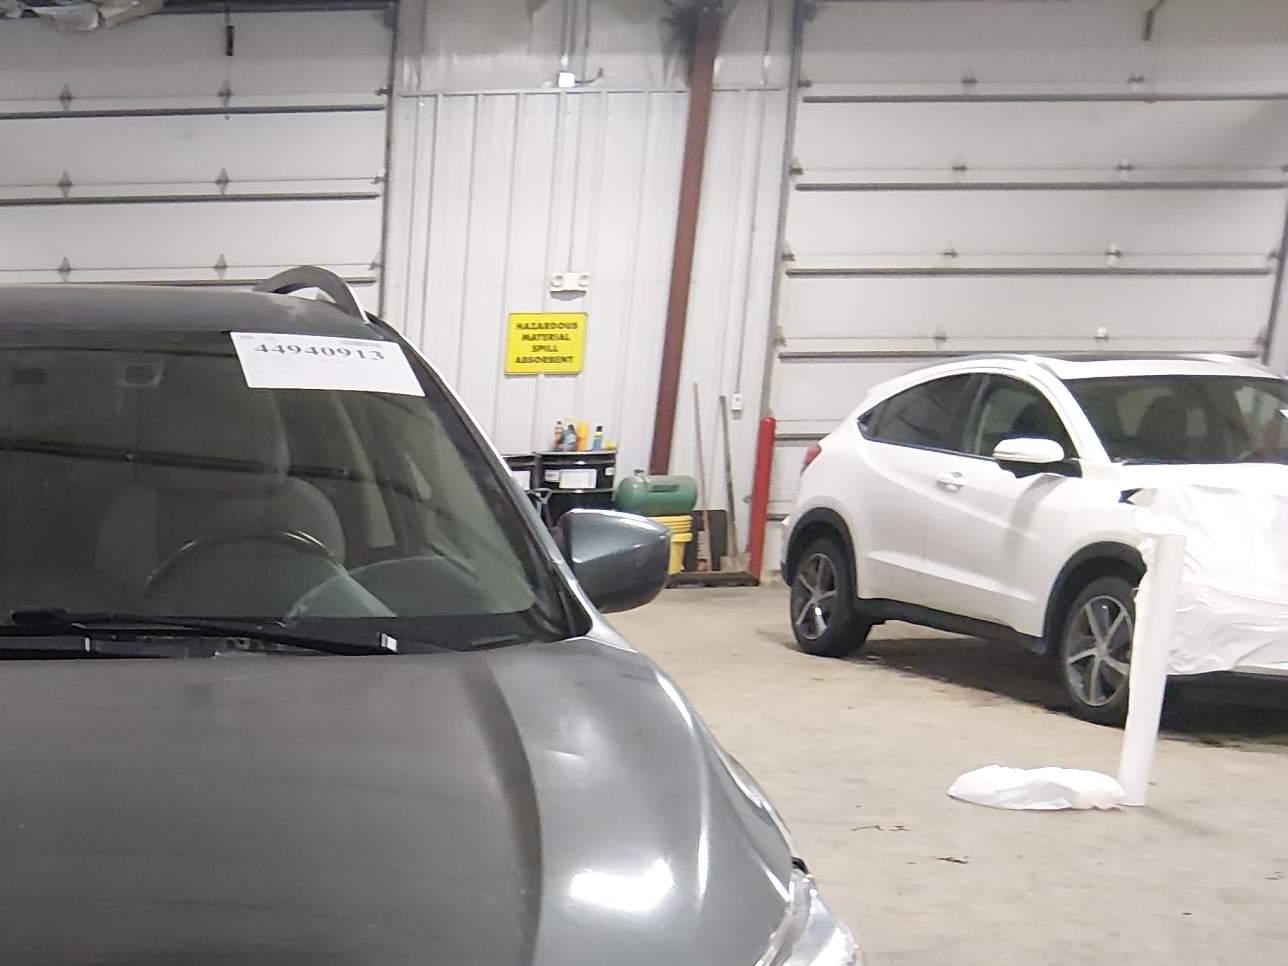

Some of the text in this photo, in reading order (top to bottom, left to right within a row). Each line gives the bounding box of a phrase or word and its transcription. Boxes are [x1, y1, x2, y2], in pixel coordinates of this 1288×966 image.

[516, 322, 578, 330] HAZARDOUS
[521, 333, 570, 341] MATERIAL
[254, 343, 385, 361] 44940913
[531, 344, 559, 353] SPILL
[515, 355, 574, 364] ABSORBENT
